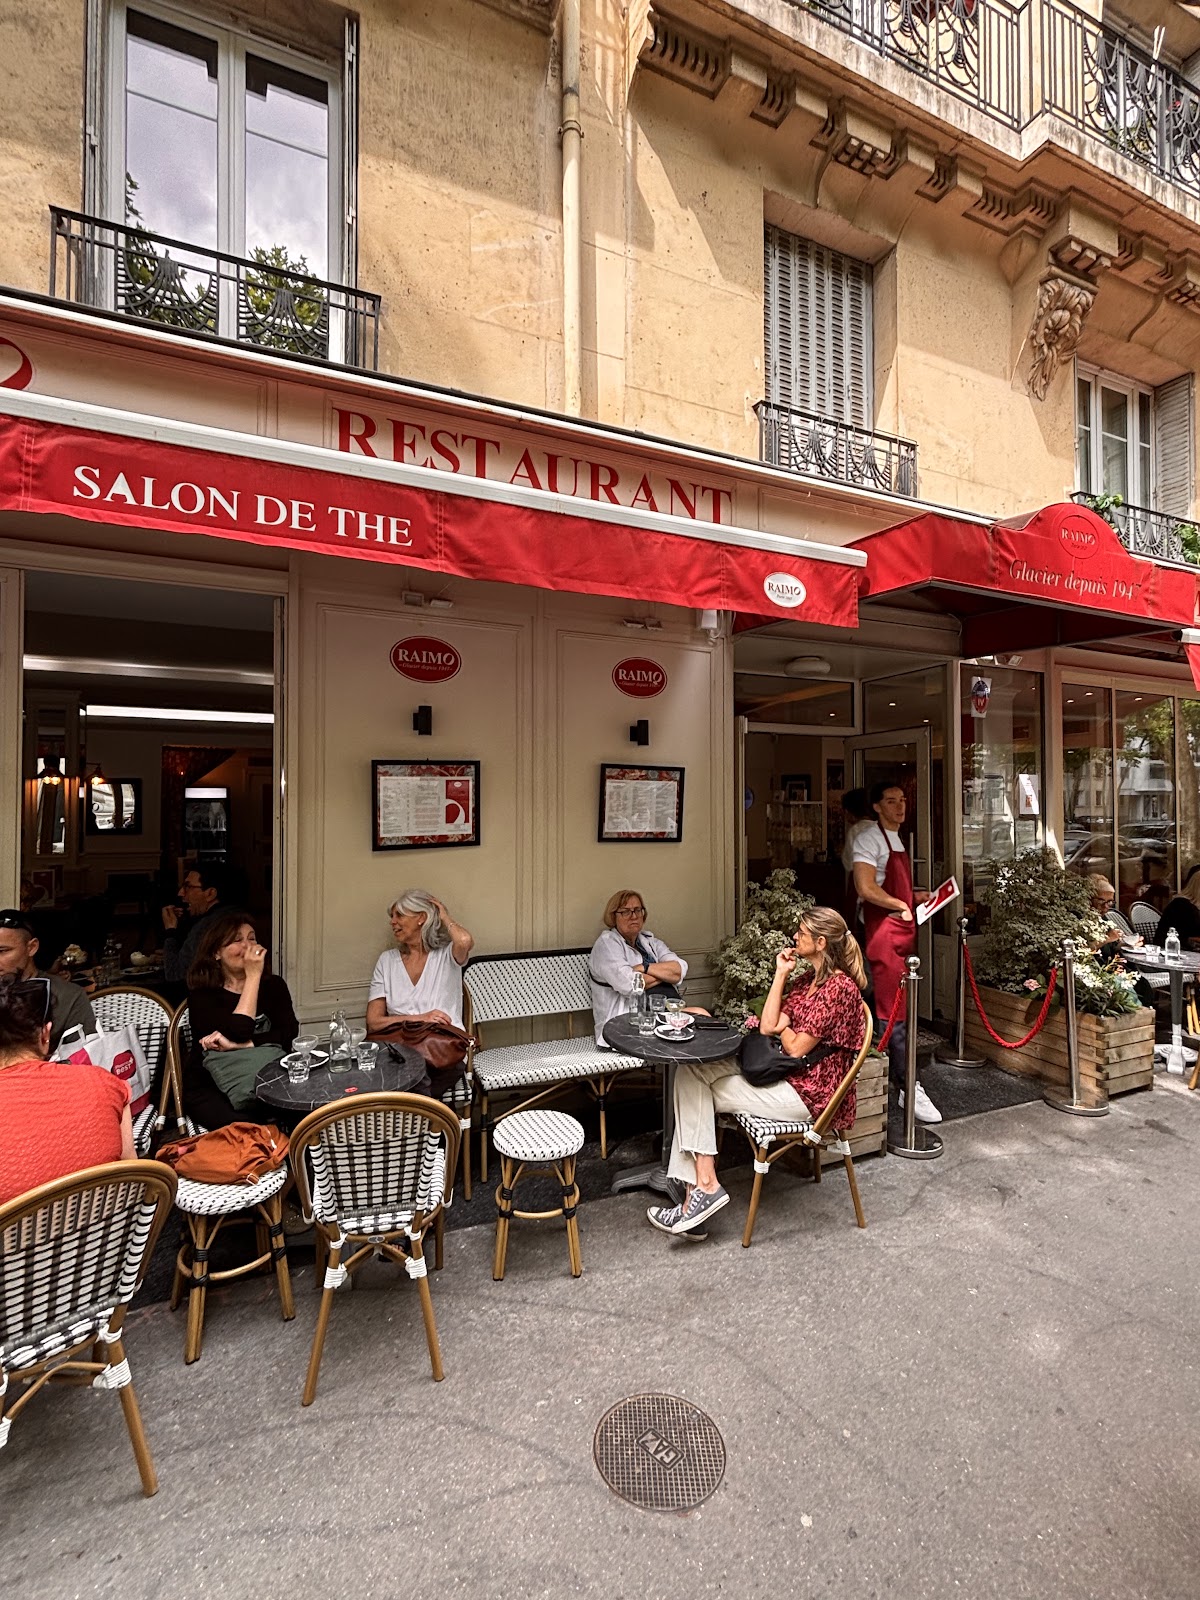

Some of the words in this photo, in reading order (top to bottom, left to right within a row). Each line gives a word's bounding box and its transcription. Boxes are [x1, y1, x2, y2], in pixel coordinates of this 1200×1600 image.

[332, 407, 732, 525] RESTAURANT
[73, 465, 241, 521] SALON
[254, 494, 317, 532] DE
[328, 506, 413, 547] THE
[1061, 527, 1096, 546] RAIMO
[768, 582, 801, 596] RAIMO
[1009, 559, 1062, 586] Glacier
[1064, 570, 1108, 596] depuis
[397, 649, 455, 665] RAIMO
[641, 1432, 679, 1465] GAZ
